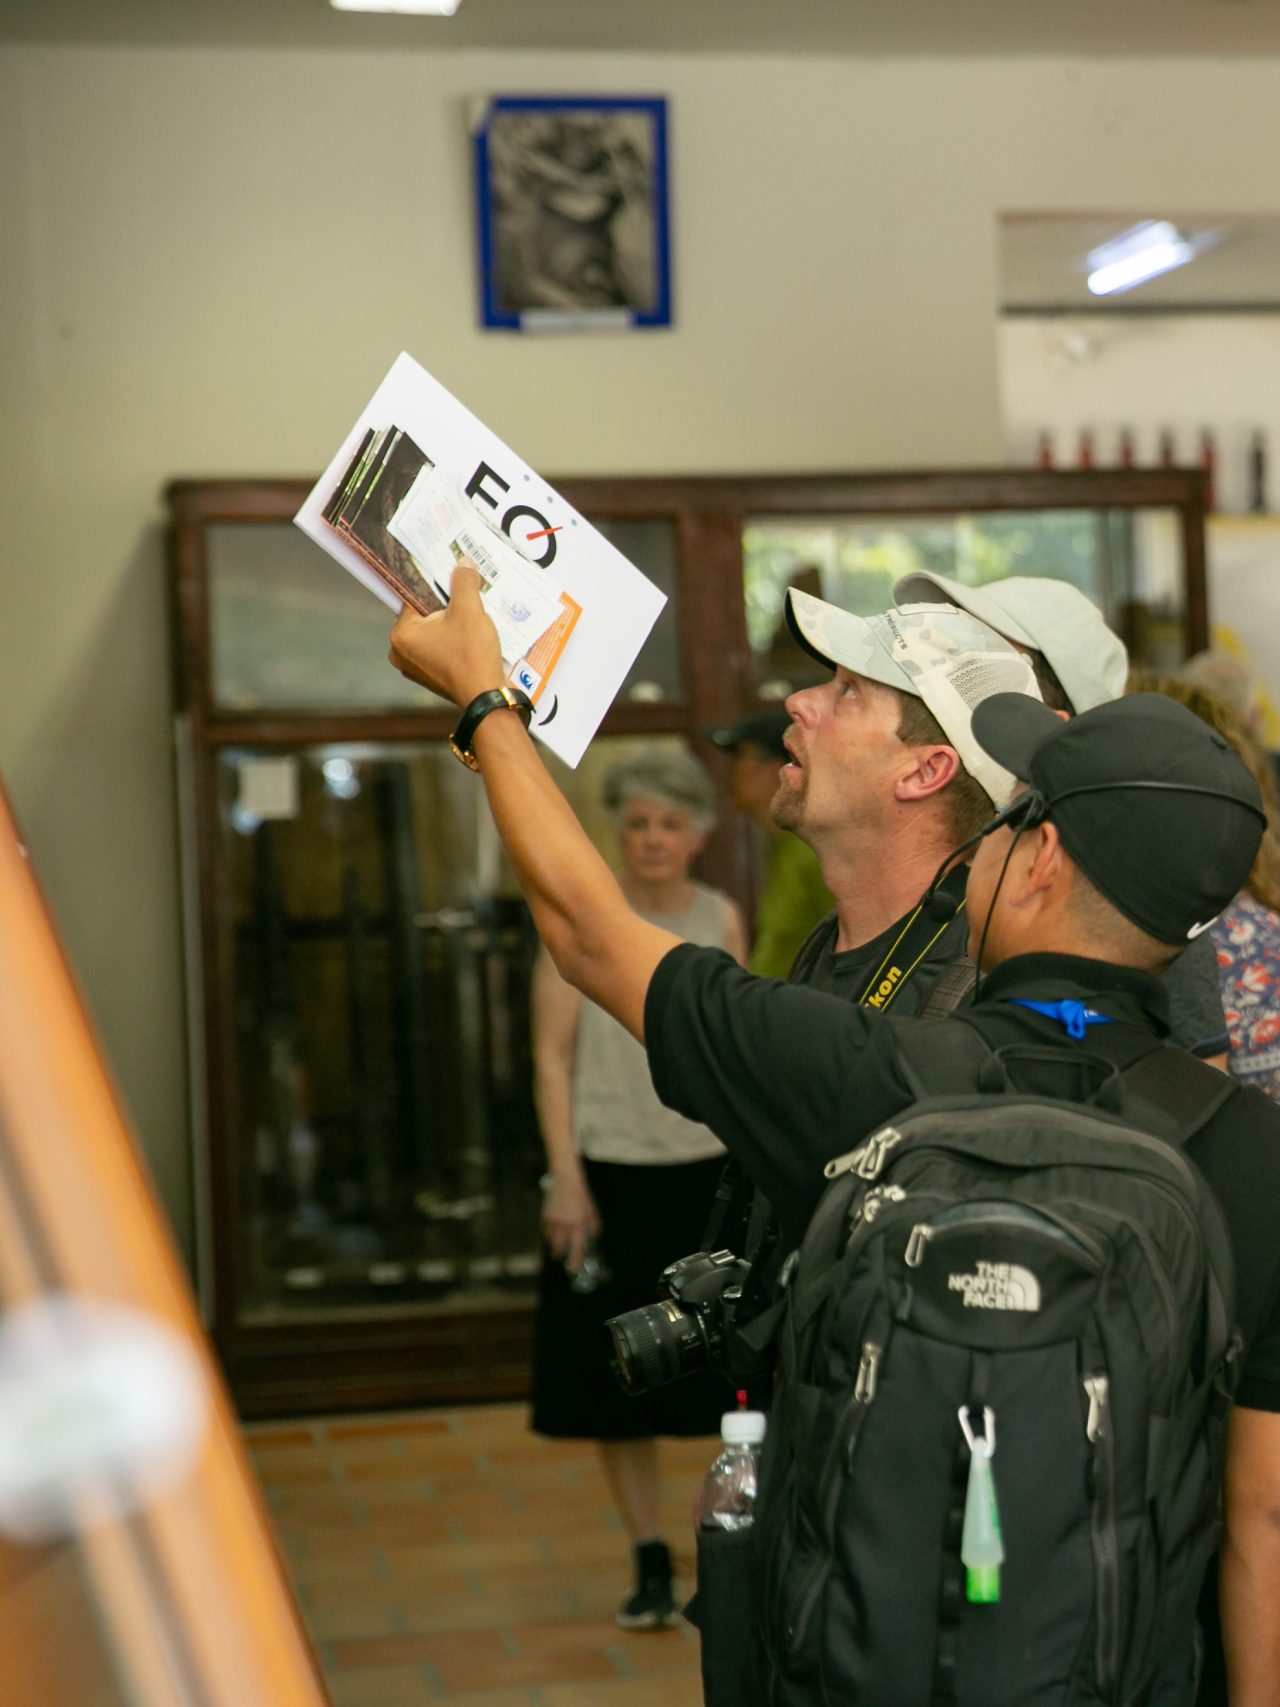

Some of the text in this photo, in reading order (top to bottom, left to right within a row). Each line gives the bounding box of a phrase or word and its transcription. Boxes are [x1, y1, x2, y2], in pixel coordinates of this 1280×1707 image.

[865, 966, 902, 1008] kon
[976, 1262, 1009, 1280] THE
[948, 1273, 1007, 1295] NORTH
[963, 1291, 1006, 1309] FACE
